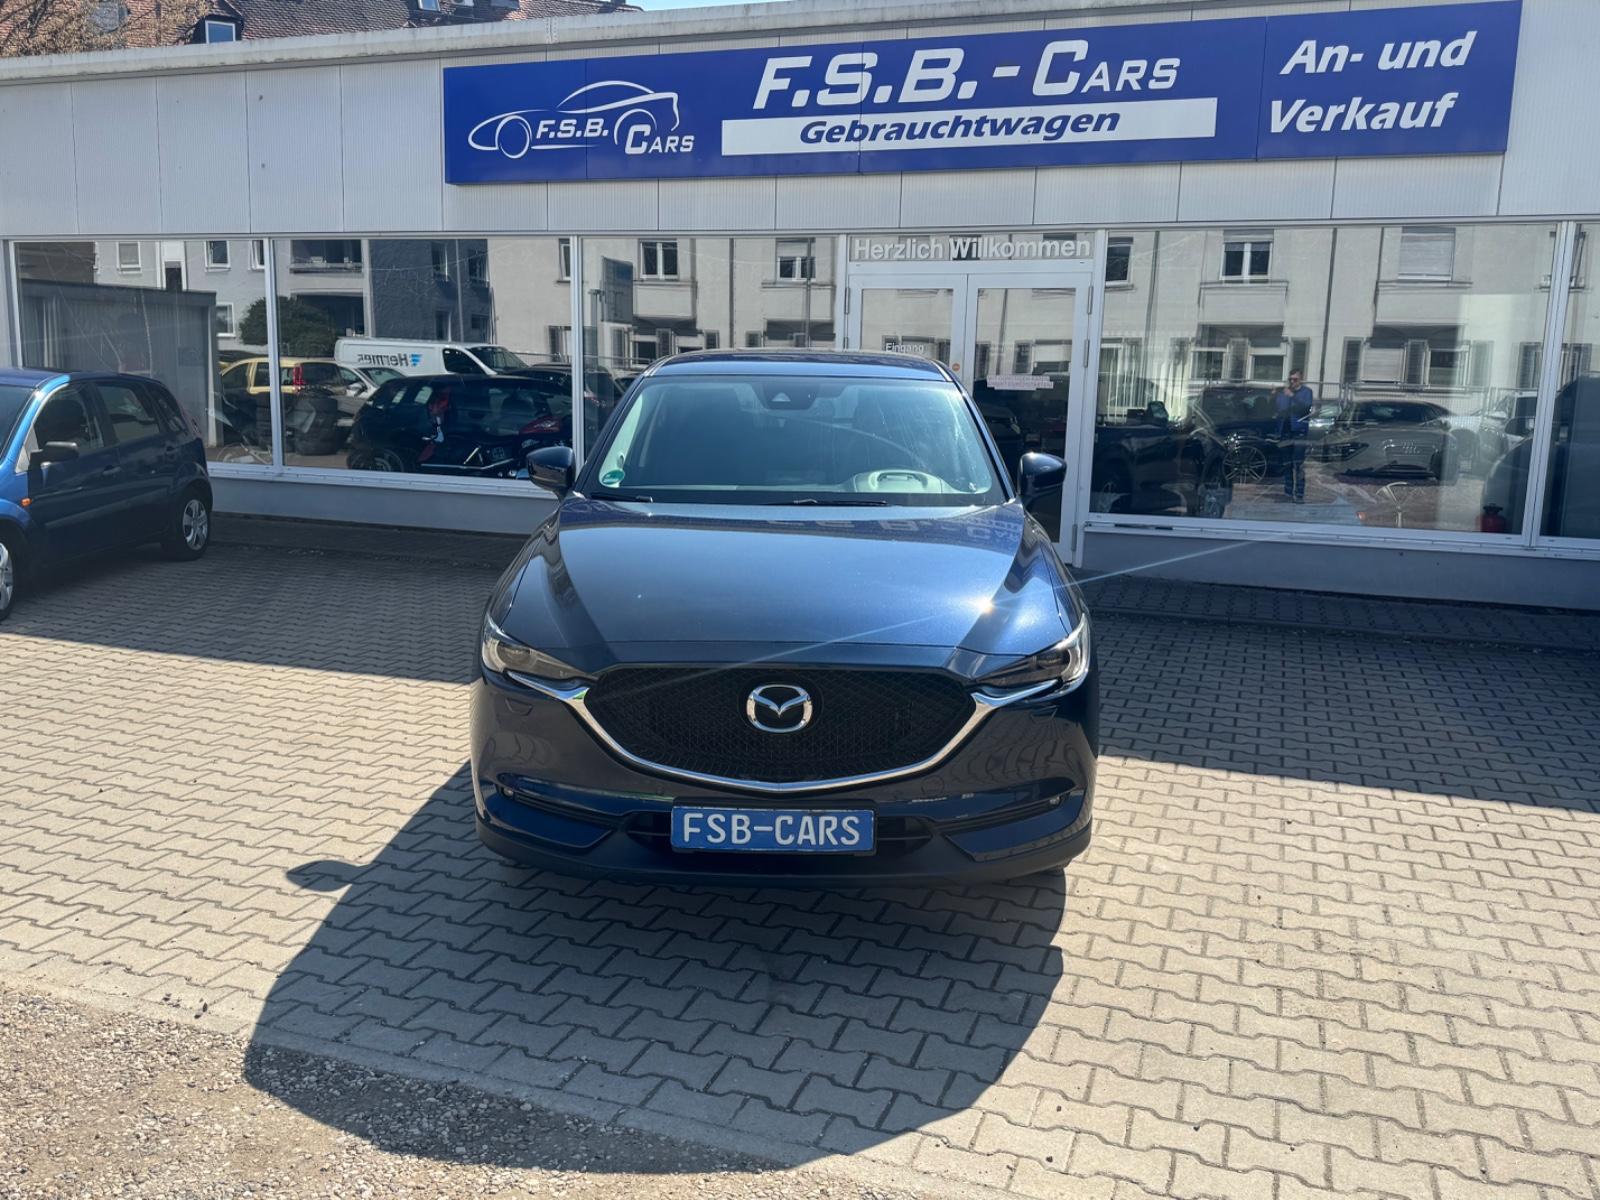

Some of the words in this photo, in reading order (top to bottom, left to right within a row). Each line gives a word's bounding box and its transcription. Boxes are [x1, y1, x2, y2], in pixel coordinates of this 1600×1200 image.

[1280, 38, 1363, 76] An-
[1377, 30, 1477, 71] und
[535, 117, 609, 140] F.S.B.
[799, 110, 1121, 145] Gebrauchtwagen
[1270, 92, 1459, 134] Verkauf
[854, 238, 943, 260] Herzlich
[949, 237, 1091, 258] Willkommen
[885, 342, 924, 354] Eingang
[683, 812, 860, 846] FSB-CARS
